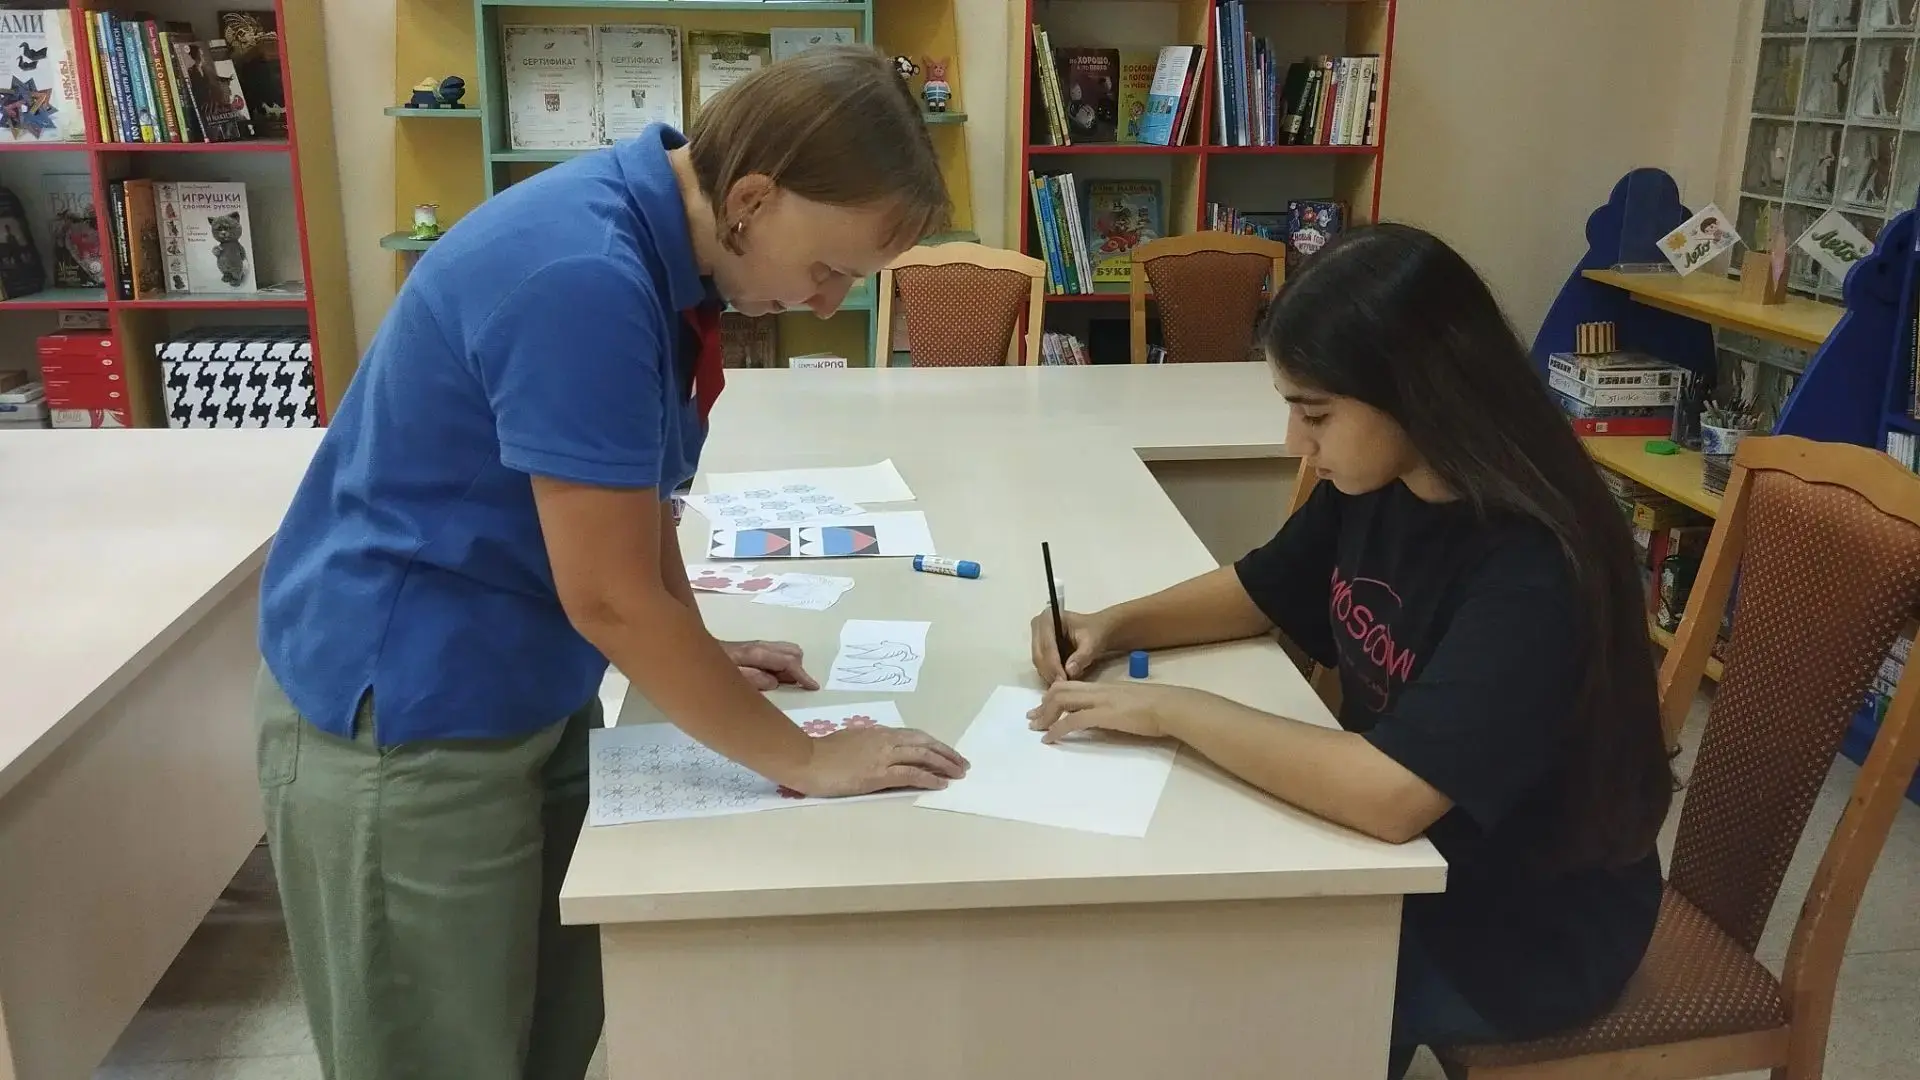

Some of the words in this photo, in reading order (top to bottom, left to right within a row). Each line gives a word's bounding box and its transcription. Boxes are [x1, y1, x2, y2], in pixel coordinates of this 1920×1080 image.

[0, 14, 45, 33] АМИ
[522, 57, 577, 66] СЕРТИФИКАТ
[610, 56, 665, 65] СЕРТИФИКАТ
[182, 192, 241, 203] ИГРУШКИ
[1684, 239, 1711, 269] Лето
[1812, 229, 1861, 263] Лето
[1330, 565, 1417, 683] MOSCOW
